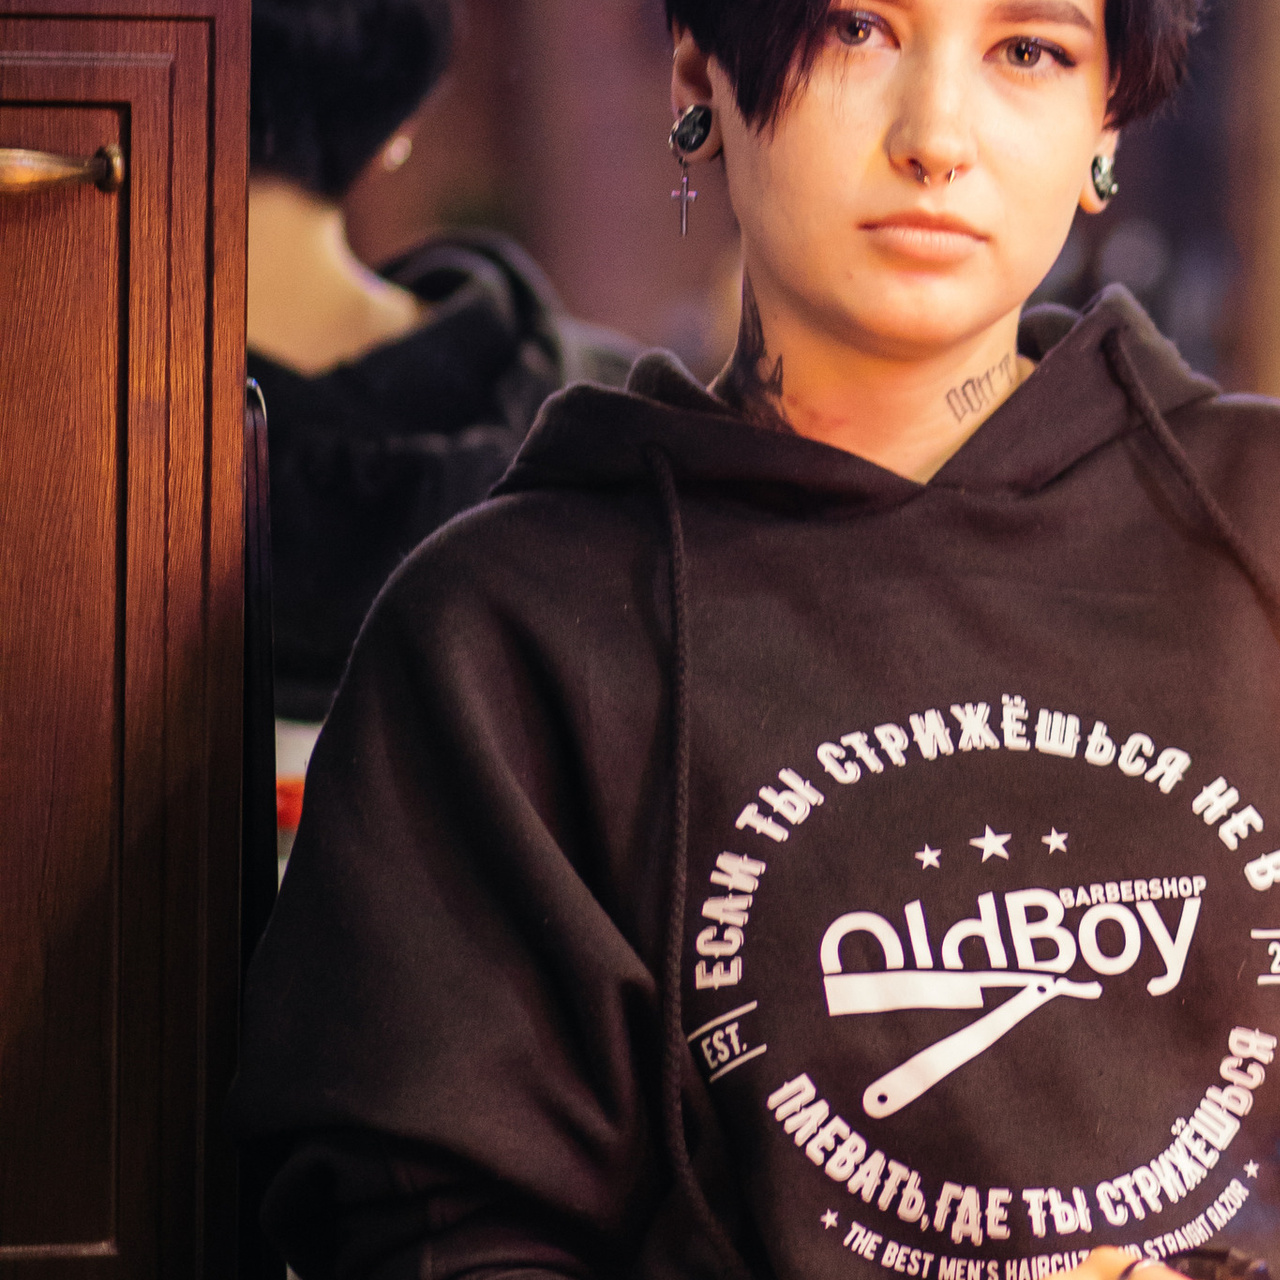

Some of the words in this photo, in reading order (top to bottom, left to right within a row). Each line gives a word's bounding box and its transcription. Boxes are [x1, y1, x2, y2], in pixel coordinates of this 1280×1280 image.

[694, 850, 767, 991] ЕСЛИ
[734, 767, 825, 843] ТЫ
[816, 693, 1193, 795] СТРИЖЁШЬСЯ
[1191, 775, 1264, 852] НЕ
[1059, 875, 1207, 909] BARBERSHOP
[820, 887, 1202, 997] OldBoy
[700, 1021, 748, 1070] EST.
[1021, 1186, 1093, 1239] ТЫ
[1095, 1025, 1278, 1228] СТРИЖЁШЬСЯ
[842, 1220, 883, 1262] THE
[880, 1239, 935, 1280] BEST
[1143, 1212, 1214, 1261] STRAIGHT
[1205, 1177, 1250, 1232] RAZOR
